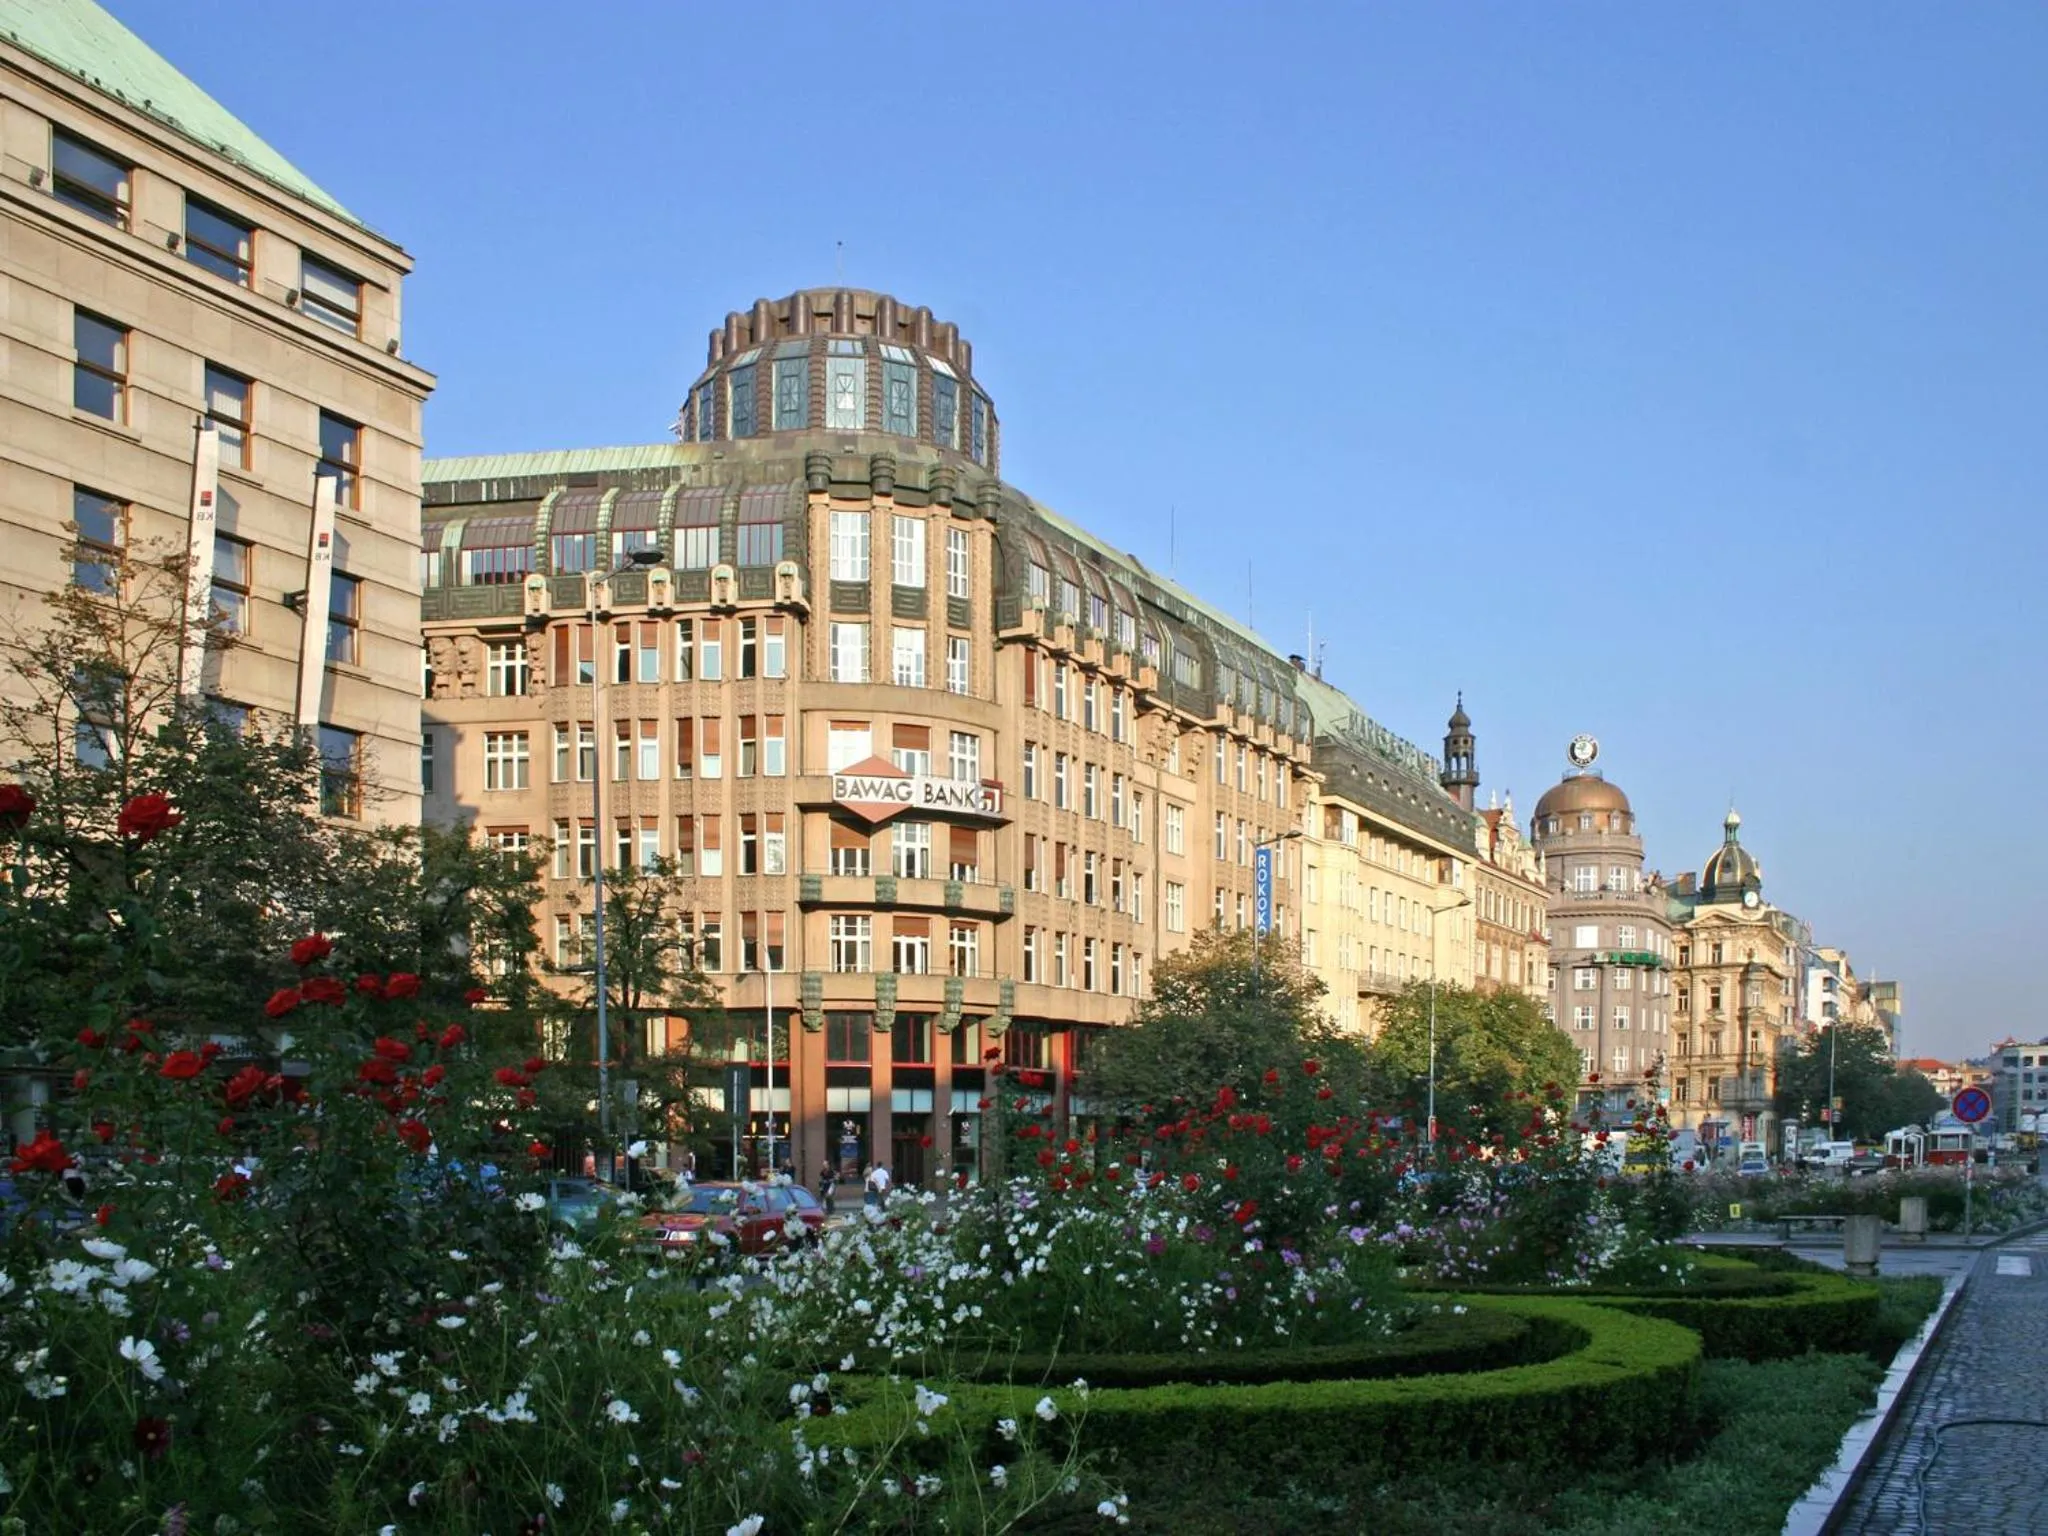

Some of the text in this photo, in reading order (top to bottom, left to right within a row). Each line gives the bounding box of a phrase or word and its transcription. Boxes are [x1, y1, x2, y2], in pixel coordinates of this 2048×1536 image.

[834, 778, 976, 809] BAWAG BANK
[1257, 854, 1268, 940] ROKOKO
